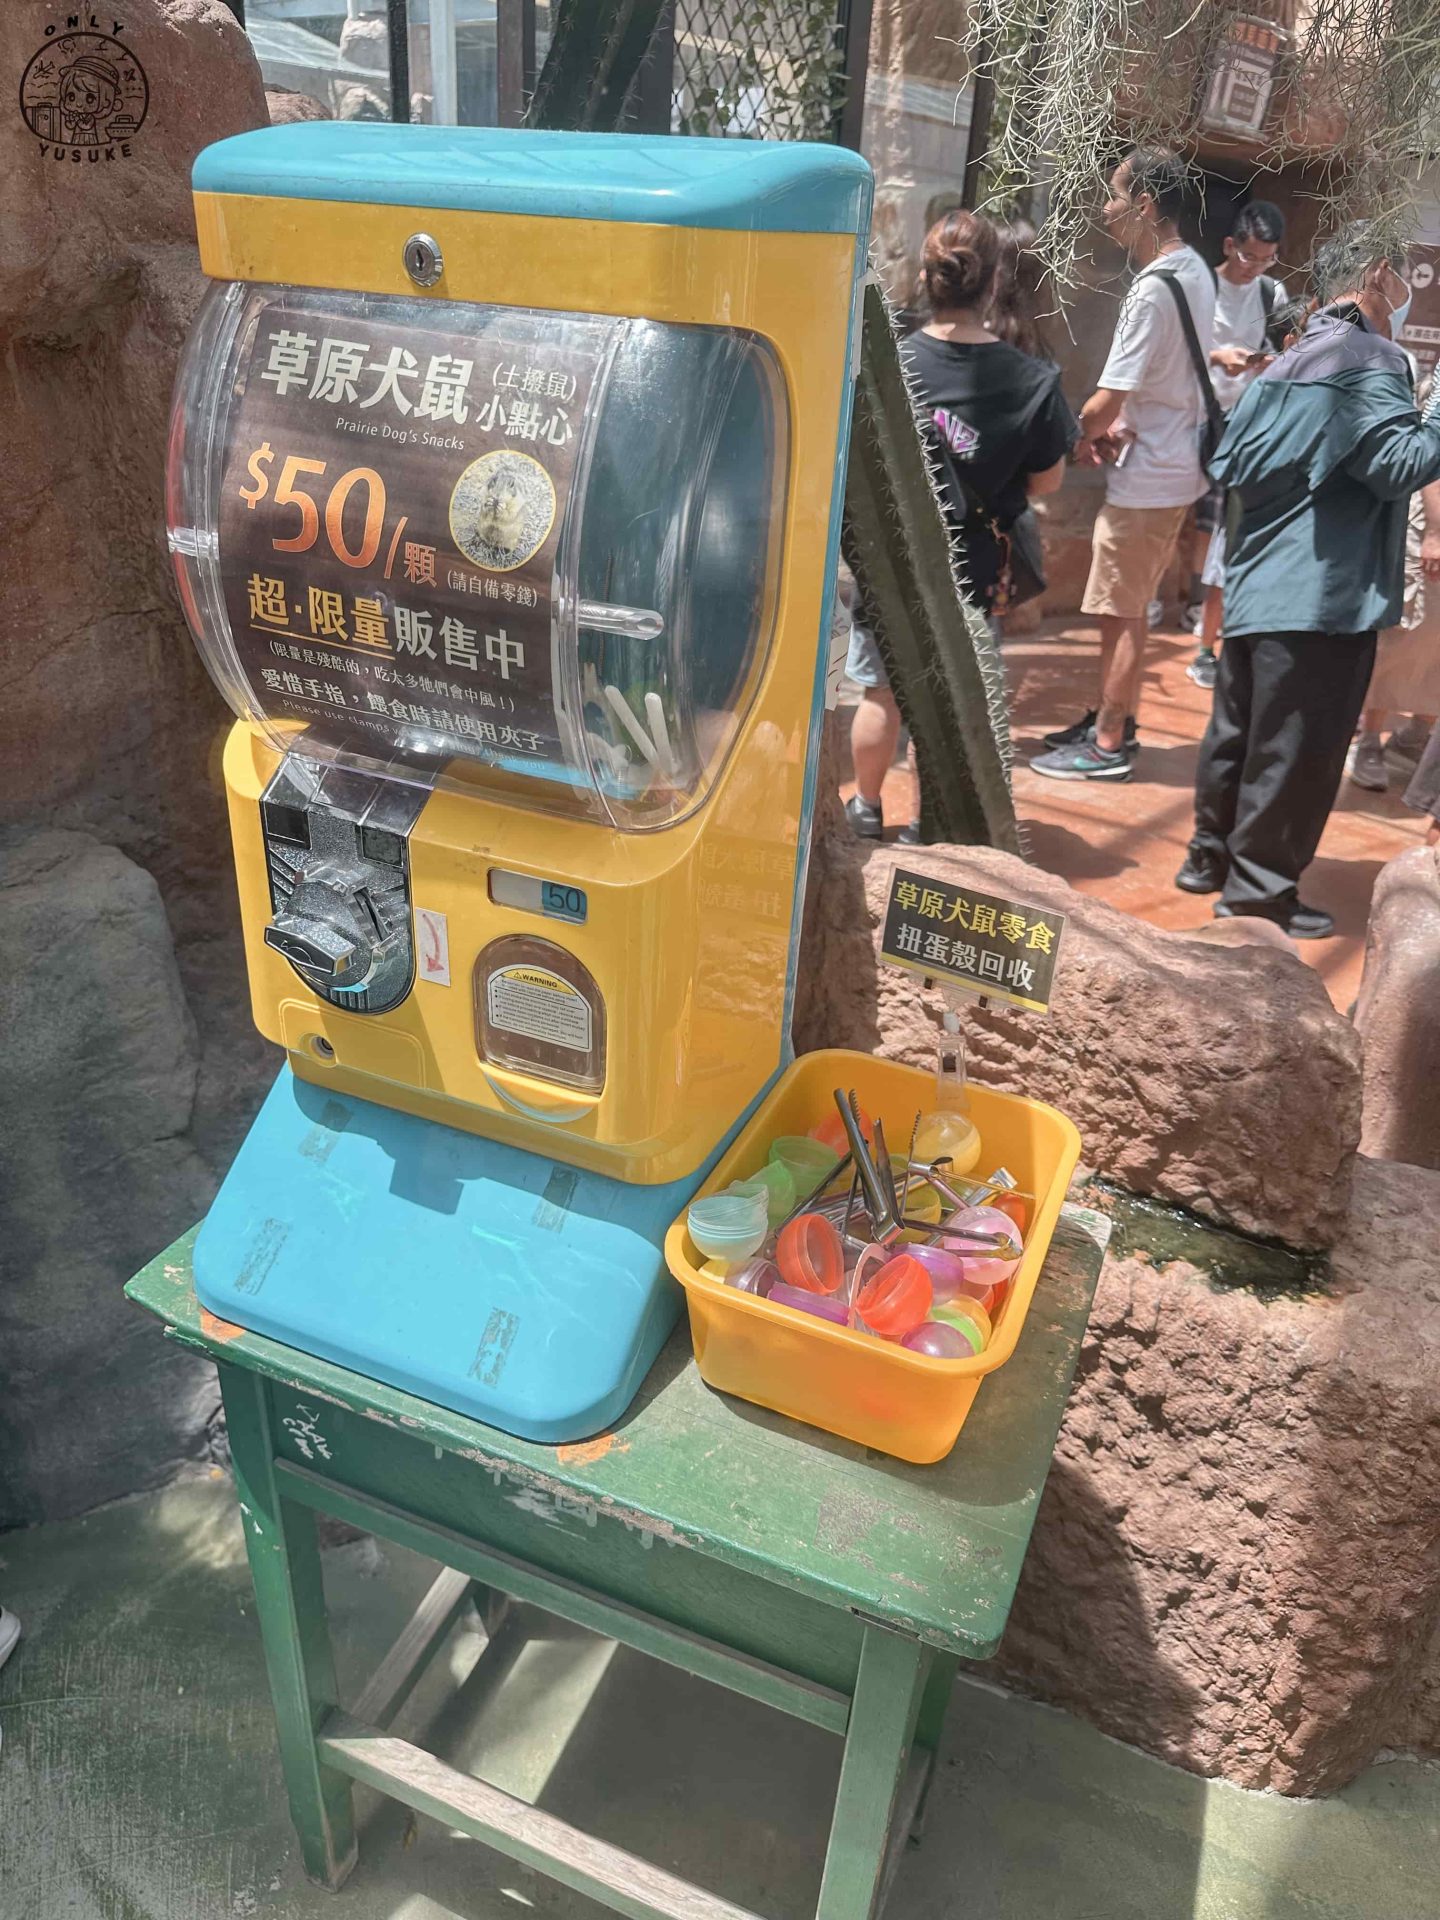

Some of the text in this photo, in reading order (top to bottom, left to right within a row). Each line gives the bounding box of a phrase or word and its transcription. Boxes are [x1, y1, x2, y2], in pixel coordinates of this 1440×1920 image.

[261, 330, 474, 425] 草原犬鼠
[336, 417, 465, 450] Prairie Dog's Snacks
[475, 395, 573, 446] 小點心
[282, 699, 321, 716] Please
[324, 710, 345, 721] use
[348, 715, 390, 733] clamps
[549, 884, 582, 911] 50
[894, 881, 1056, 955] 草原犬鼠零食
[896, 923, 1036, 991] 扭蛋殼回收
[522, 974, 558, 988] WARNING
